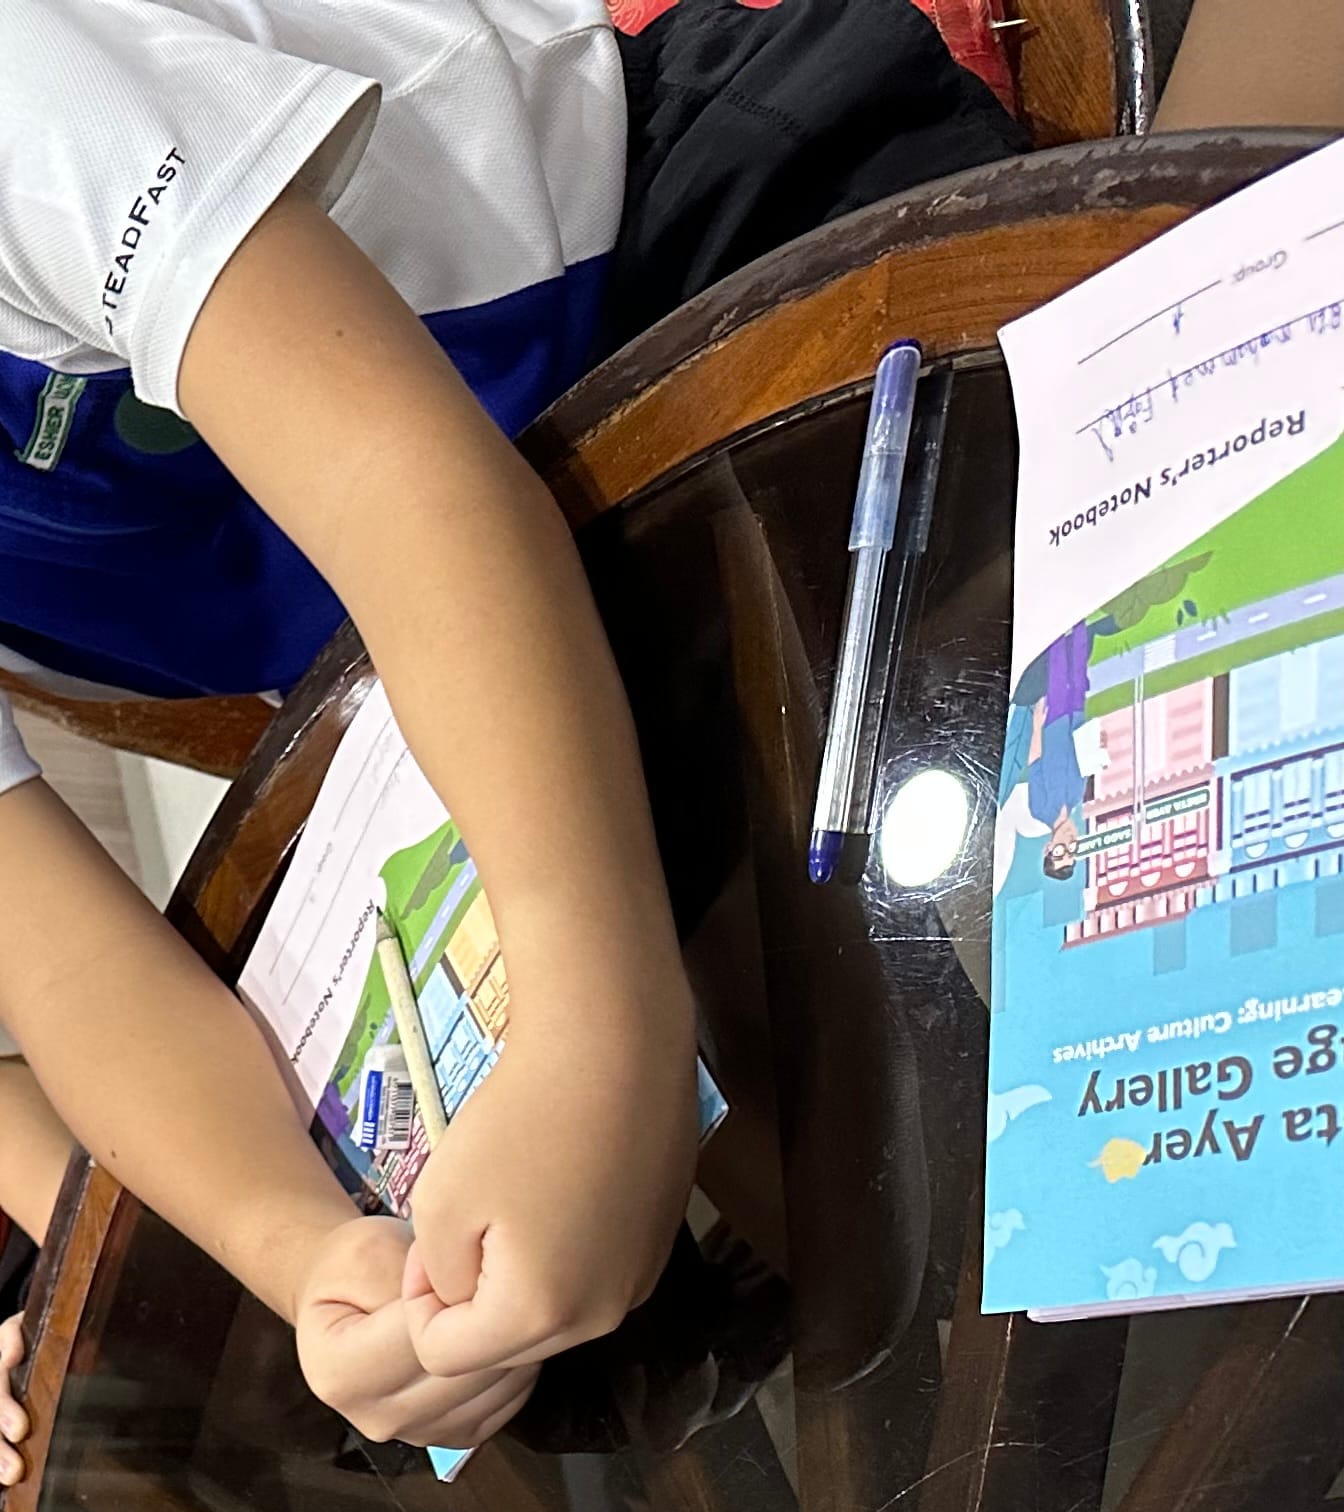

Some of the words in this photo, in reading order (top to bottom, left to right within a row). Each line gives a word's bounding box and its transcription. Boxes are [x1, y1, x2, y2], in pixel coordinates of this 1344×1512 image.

[1158, 410, 1305, 486] Reporter's
[1048, 477, 1152, 547] Notebook
[330, 898, 376, 984] Reporter's
[289, 988, 335, 1065] Notebook
[1147, 1011, 1232, 1043] Culture
[1237, 987, 1343, 1024] earning:
[1052, 1030, 1142, 1064] Archives
[1272, 1024, 1342, 1079] ge
[1078, 1056, 1253, 1117] Gallery
[1141, 1108, 1264, 1166] Ayer
[1281, 1104, 1340, 1147] ta
